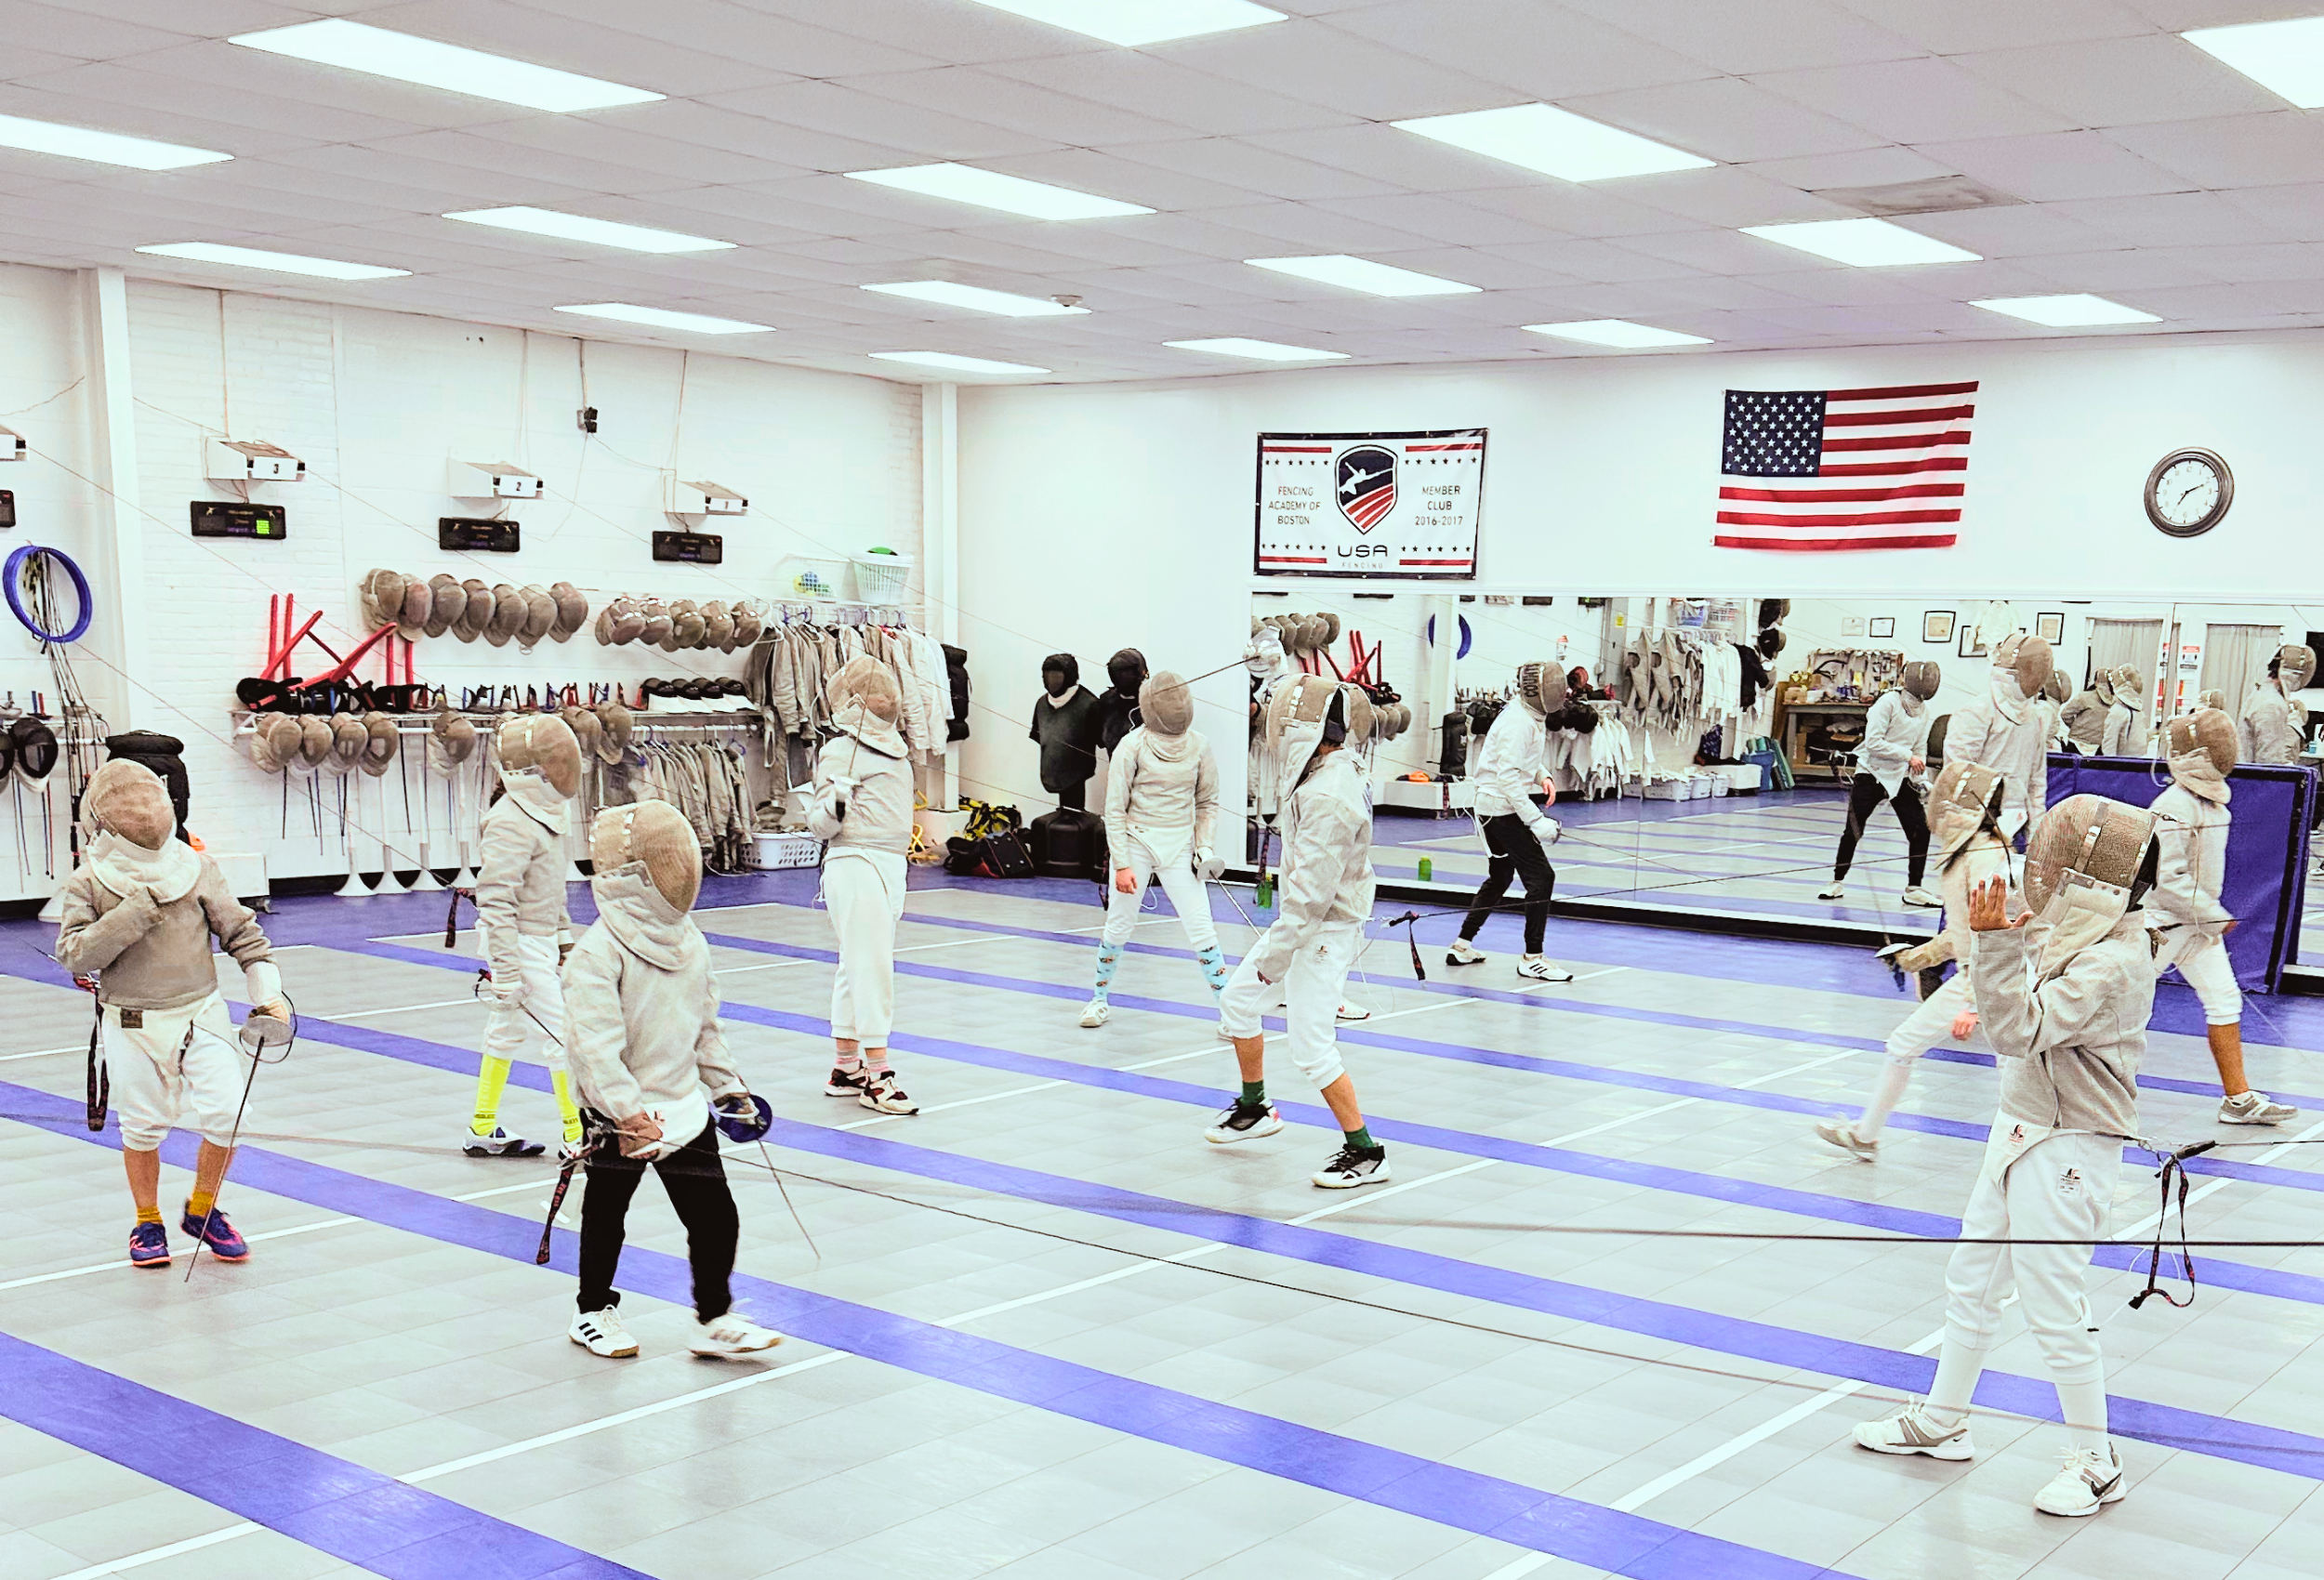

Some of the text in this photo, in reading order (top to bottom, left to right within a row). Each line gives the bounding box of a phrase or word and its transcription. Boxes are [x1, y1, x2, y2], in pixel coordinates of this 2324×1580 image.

[273, 463, 280, 475] 3
[516, 481, 522, 492] 2
[1277, 485, 1314, 496] FENCING
[1421, 484, 1461, 495] MEMBER
[1267, 500, 1321, 510] ACADEMY OF
[1427, 500, 1452, 510] CLUB
[1277, 515, 1310, 525] BOSTON
[1414, 515, 1463, 526] 2016-2017
[1337, 544, 1388, 558] USA
